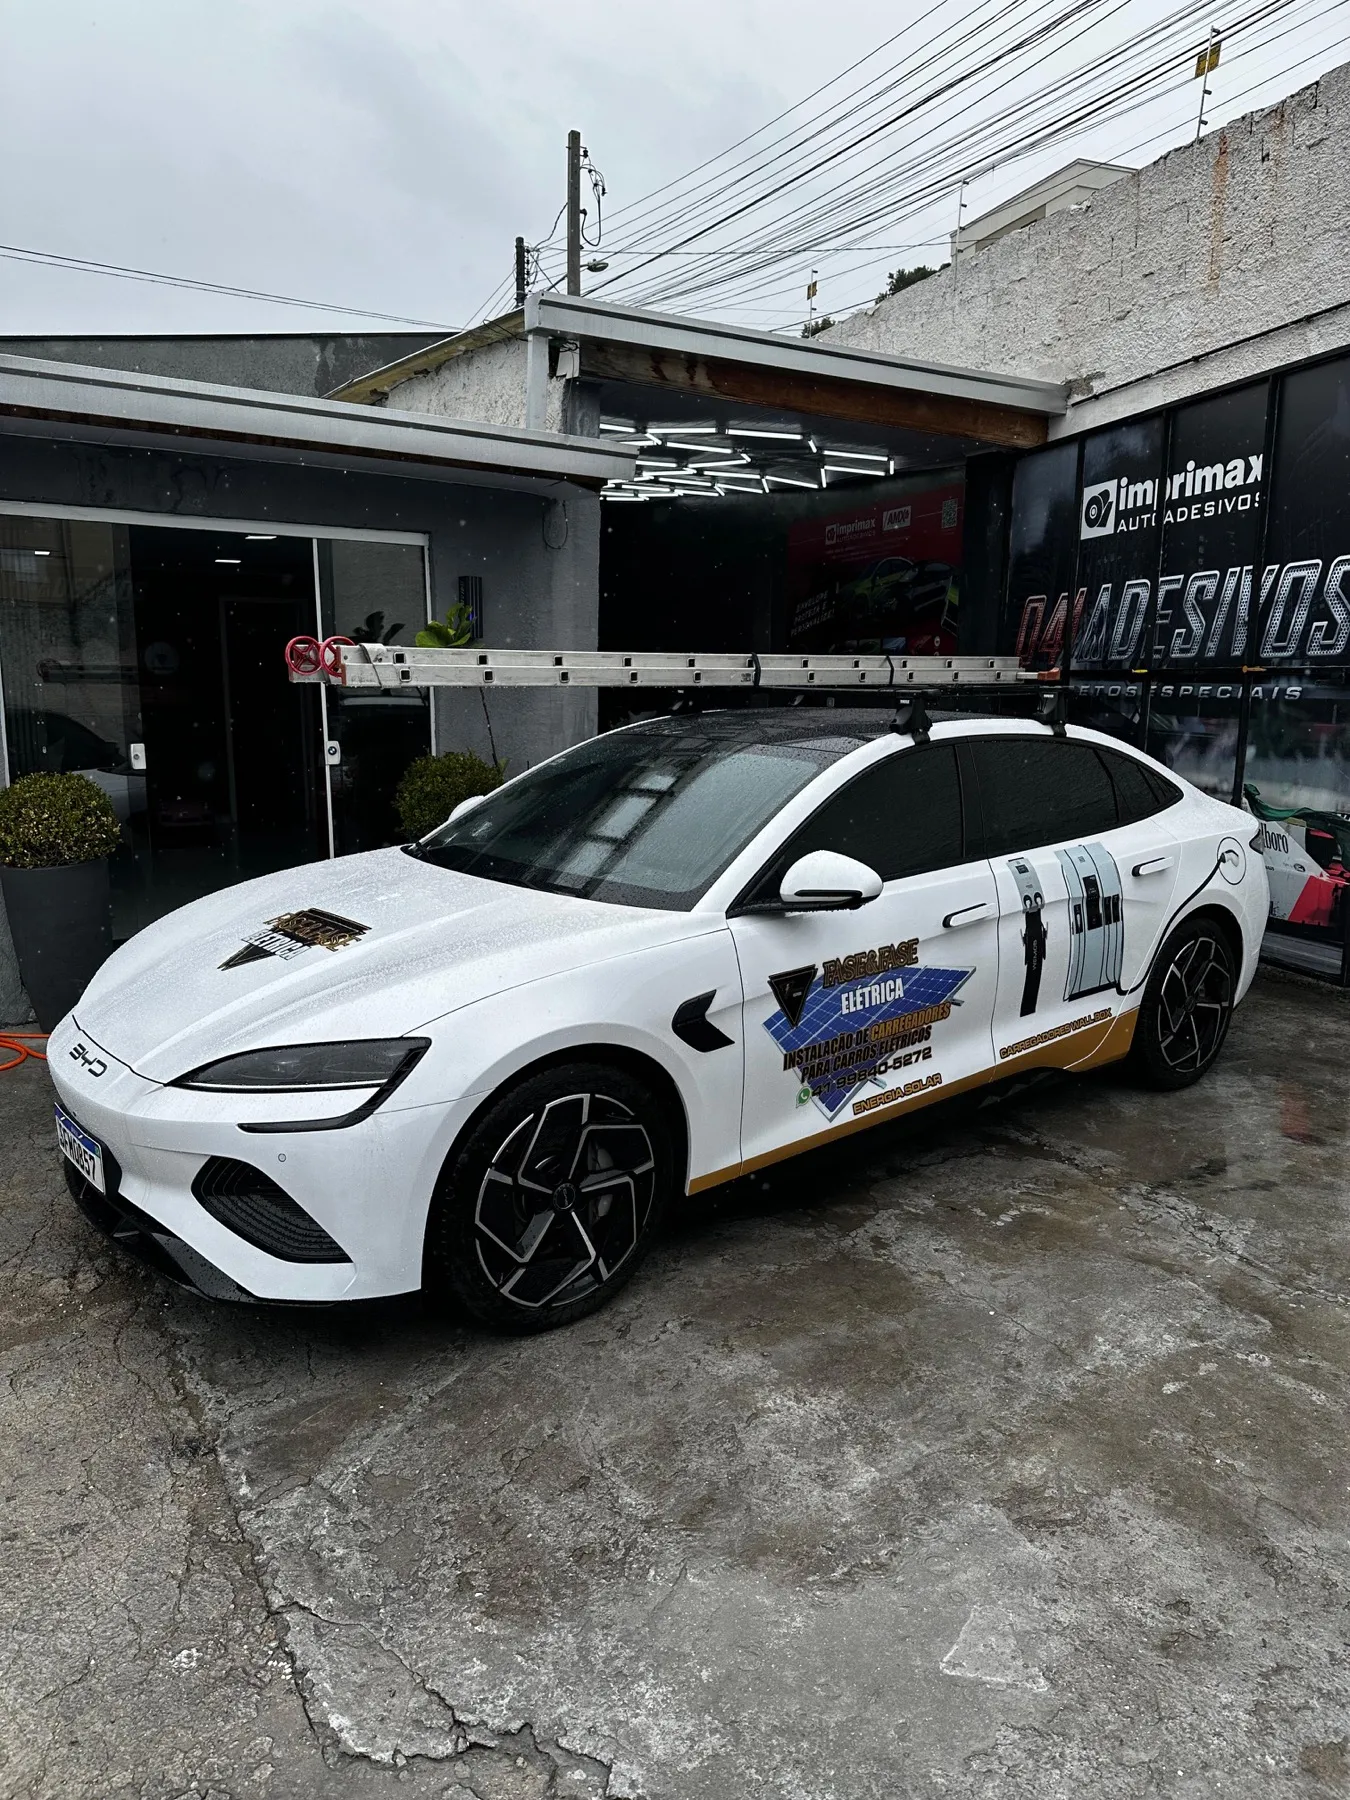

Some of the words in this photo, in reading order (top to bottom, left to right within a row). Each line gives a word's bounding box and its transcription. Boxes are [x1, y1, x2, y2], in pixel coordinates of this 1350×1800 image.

[1118, 453, 1264, 511] imprimax
[837, 518, 876, 535] imprimax
[1078, 685, 1138, 698] ETOS
[841, 978, 904, 1015] ELÉTRICA
[783, 1032, 853, 1071] INSTALAÇÃO
[855, 1028, 870, 1046] DE
[871, 1002, 951, 1042] CARREGADORES
[1000, 1024, 1071, 1059] CARREGADORES
[1070, 1014, 1095, 1032] WALL
[1094, 1007, 1112, 1022] BOX
[69, 1043, 107, 1077] BYD
[801, 1061, 833, 1084] PARA
[833, 1044, 878, 1072] CARROS
[812, 1081, 830, 1097] 41
[852, 1087, 904, 1115] ENERGIA
[904, 1072, 942, 1096] SOLAR
